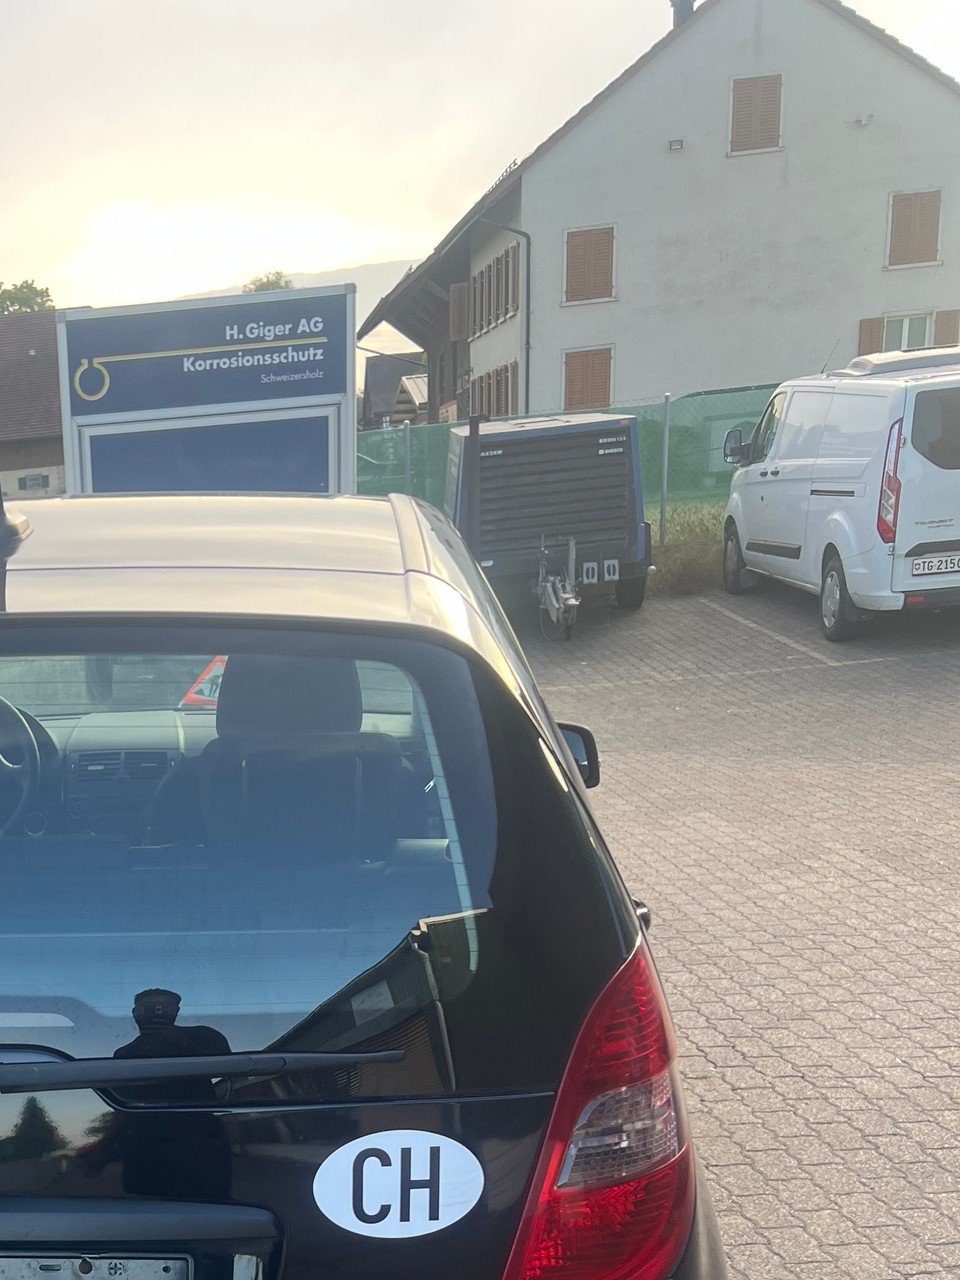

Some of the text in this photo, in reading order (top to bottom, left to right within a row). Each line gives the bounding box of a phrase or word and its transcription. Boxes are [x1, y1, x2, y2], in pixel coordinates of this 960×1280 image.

[297, 316, 325, 334] AG
[183, 347, 325, 372] Korrosionsschutz
[261, 369, 324, 384] Schweizersholz
[352, 1145, 441, 1224] CH
